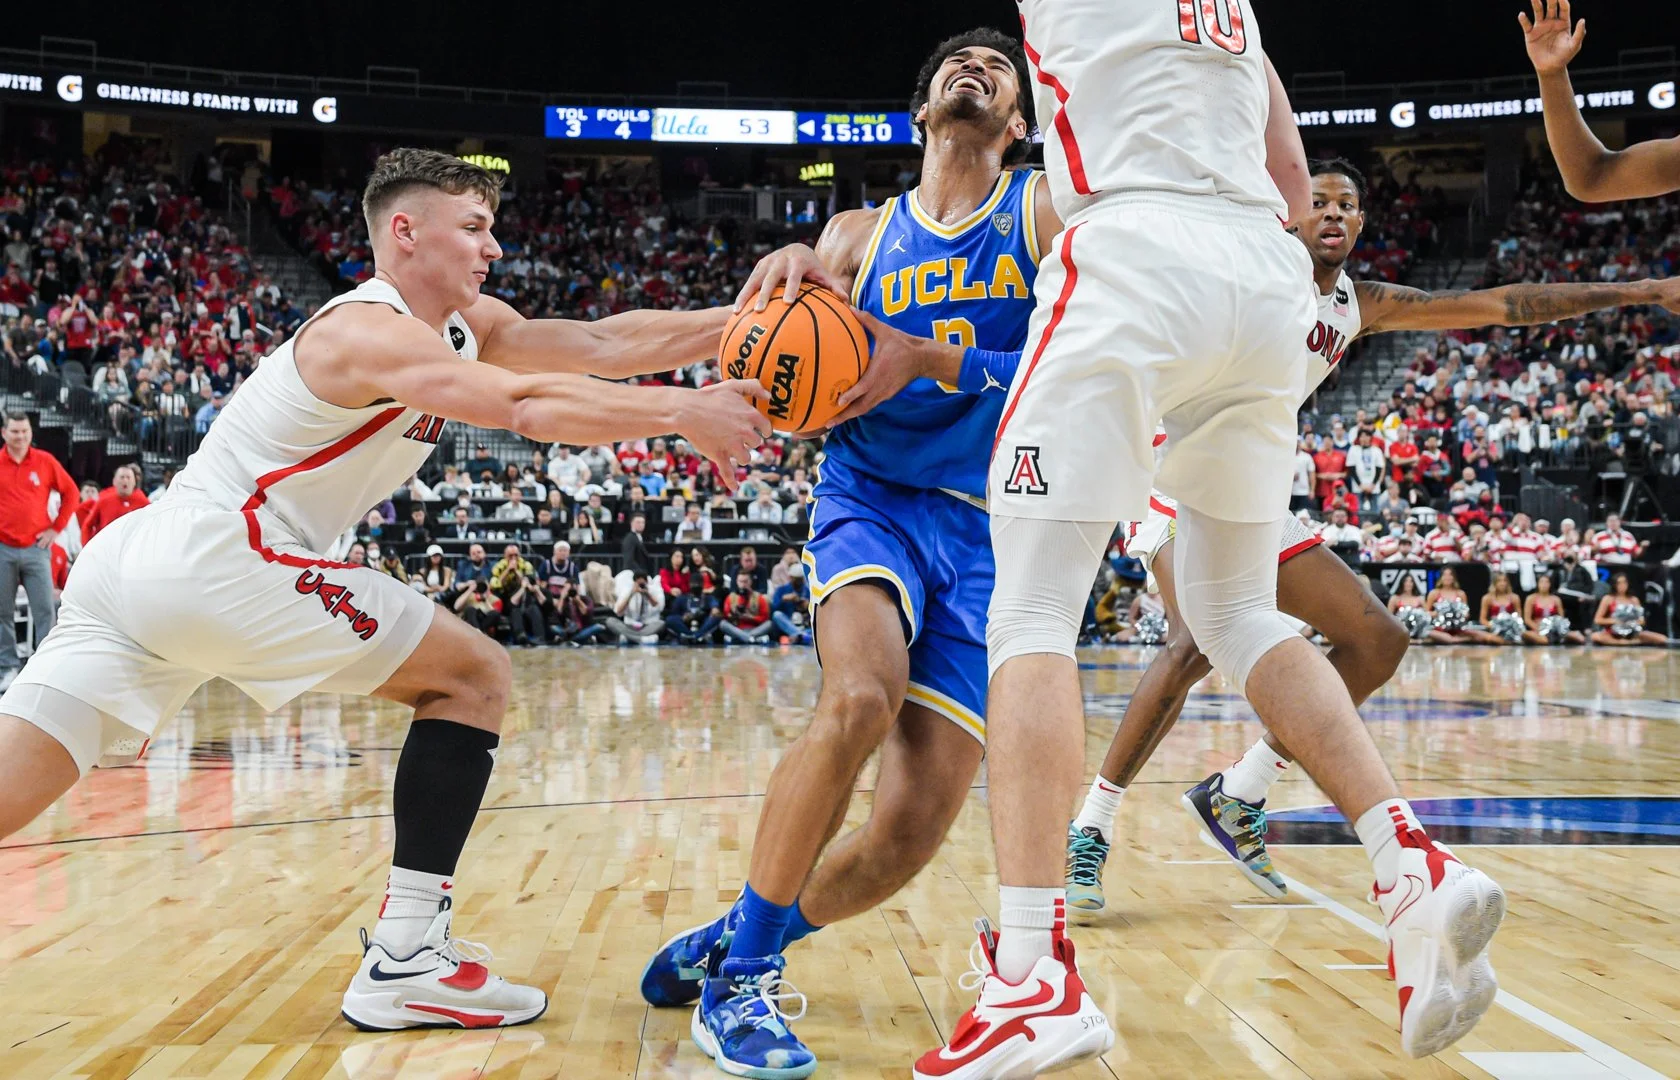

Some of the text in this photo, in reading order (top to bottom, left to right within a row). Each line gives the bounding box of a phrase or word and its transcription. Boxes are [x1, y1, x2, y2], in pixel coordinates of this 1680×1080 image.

[0, 73, 43, 92] WITH
[97, 83, 298, 114] GREATNESS STARTS WITH
[1428, 99, 1522, 120] GREATNESS
[1587, 90, 1634, 107] WITH
[556, 107, 650, 122] TOL FOULS
[739, 118, 770, 135] 53
[1332, 108, 1377, 124] WITH
[565, 120, 632, 140] 3 4
[821, 123, 892, 142] 15:10
[880, 254, 1029, 317] UCLA
[767, 353, 800, 420] NCAA
[1004, 446, 1049, 496] A
[294, 569, 379, 641] CATS
